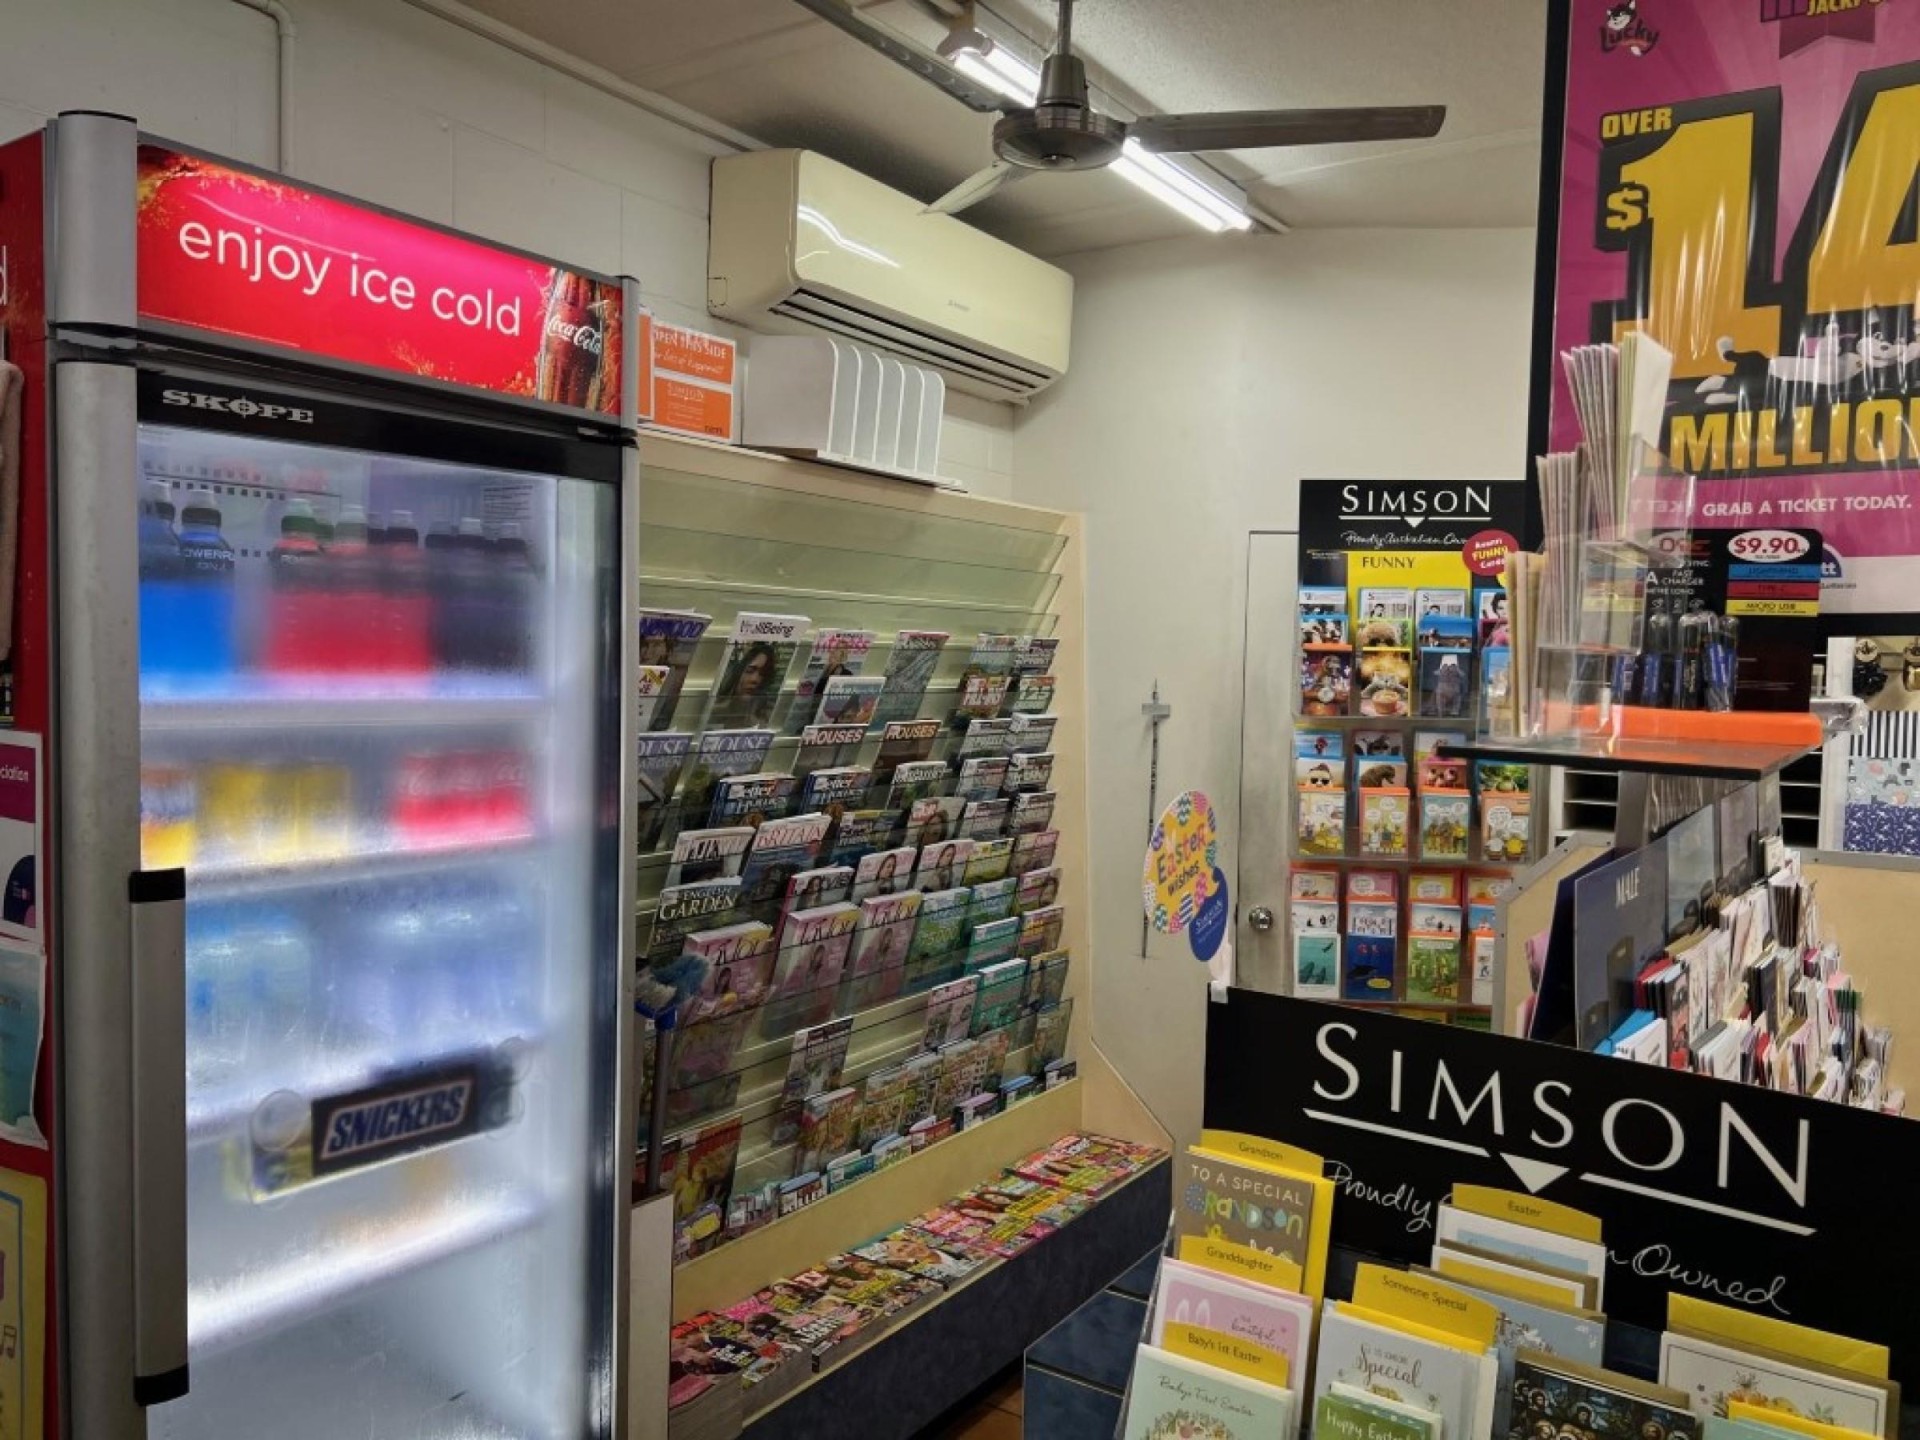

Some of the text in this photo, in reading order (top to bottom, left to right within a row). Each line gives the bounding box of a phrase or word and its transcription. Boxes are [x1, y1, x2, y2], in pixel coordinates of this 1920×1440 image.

[1602, 108, 1673, 139] OVER
[179, 221, 521, 337] enjoy ice cold
[162, 389, 314, 424] SKOPE
[1669, 396, 1920, 473] MILLIO
[1341, 484, 1492, 514] SIMSON
[1702, 502, 1753, 517] GRAB
[1758, 500, 1773, 515] A
[1778, 498, 1838, 514] TICKET
[1844, 494, 1912, 511] TODAY.
[1362, 556, 1416, 569] FUNNY
[1472, 545, 1508, 561] FUNNY
[1734, 537, 1799, 554] $9.90
[1157, 822, 1207, 884] Easter
[1167, 859, 1199, 897] wishes
[1615, 867, 1640, 909] MALE
[325, 1084, 467, 1153] SNICKERS
[1310, 1021, 1811, 1209] SIMSON
[1238, 1141, 1284, 1162] Grandson
[1191, 1164, 1304, 1207] TO A SPECIAL
[1507, 1200, 1543, 1218] Easter
[1322, 1159, 1792, 1316] Proudly Owned
[1206, 1245, 1275, 1273] Granddaughter
[1382, 1274, 1468, 1313] Someone Special
[1187, 1331, 1214, 1351] Baby's
[1232, 1345, 1263, 1364] Easter
[1354, 1343, 1422, 1389] Special
[1326, 1406, 1363, 1439] Happy
